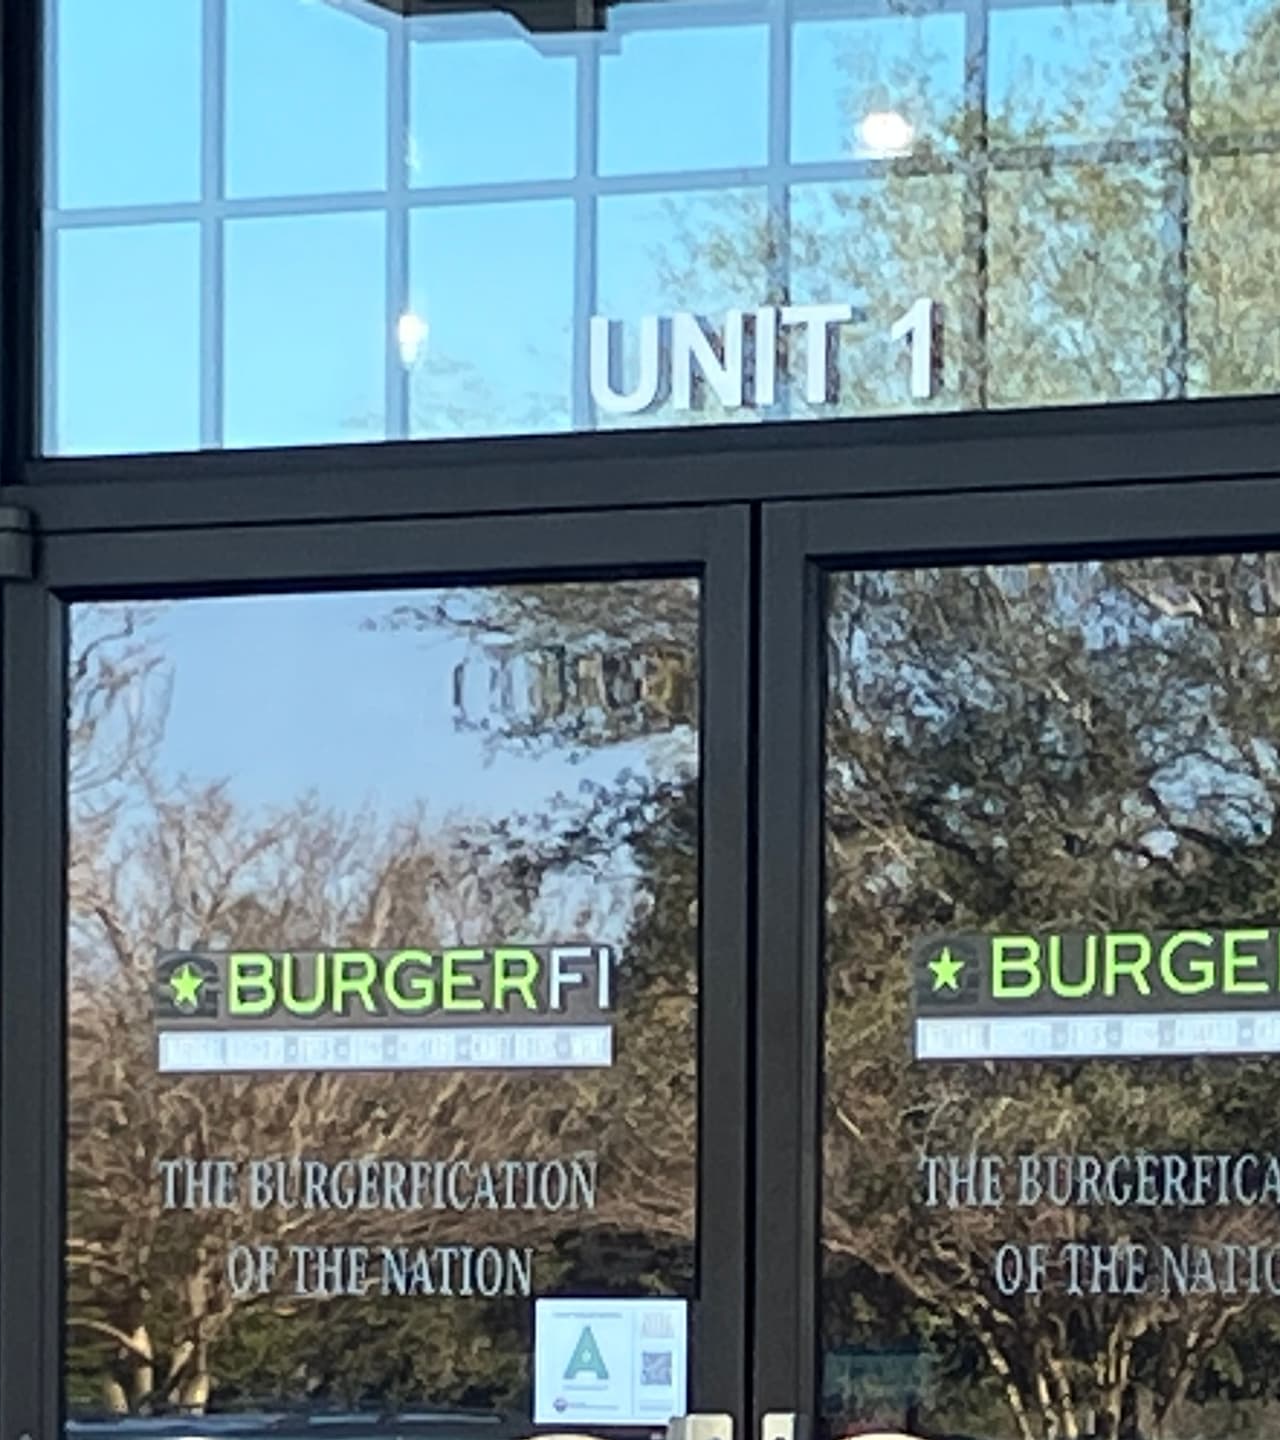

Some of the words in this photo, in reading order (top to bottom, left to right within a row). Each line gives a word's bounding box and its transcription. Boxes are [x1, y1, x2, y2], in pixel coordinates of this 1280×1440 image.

[590, 303, 853, 412] UNIT
[891, 297, 935, 399] 1
[228, 948, 611, 1014] BURGERFI
[157, 1159, 236, 1211] THE
[249, 1157, 599, 1211] BURGERFICATION
[922, 1155, 1003, 1208] THE
[226, 1246, 276, 1297] OF
[288, 1246, 368, 1295] THE
[378, 1246, 535, 1296] NATION
[995, 1244, 1051, 1297] OF
[1063, 1244, 1148, 1294] THE
[563, 1325, 610, 1380] A
